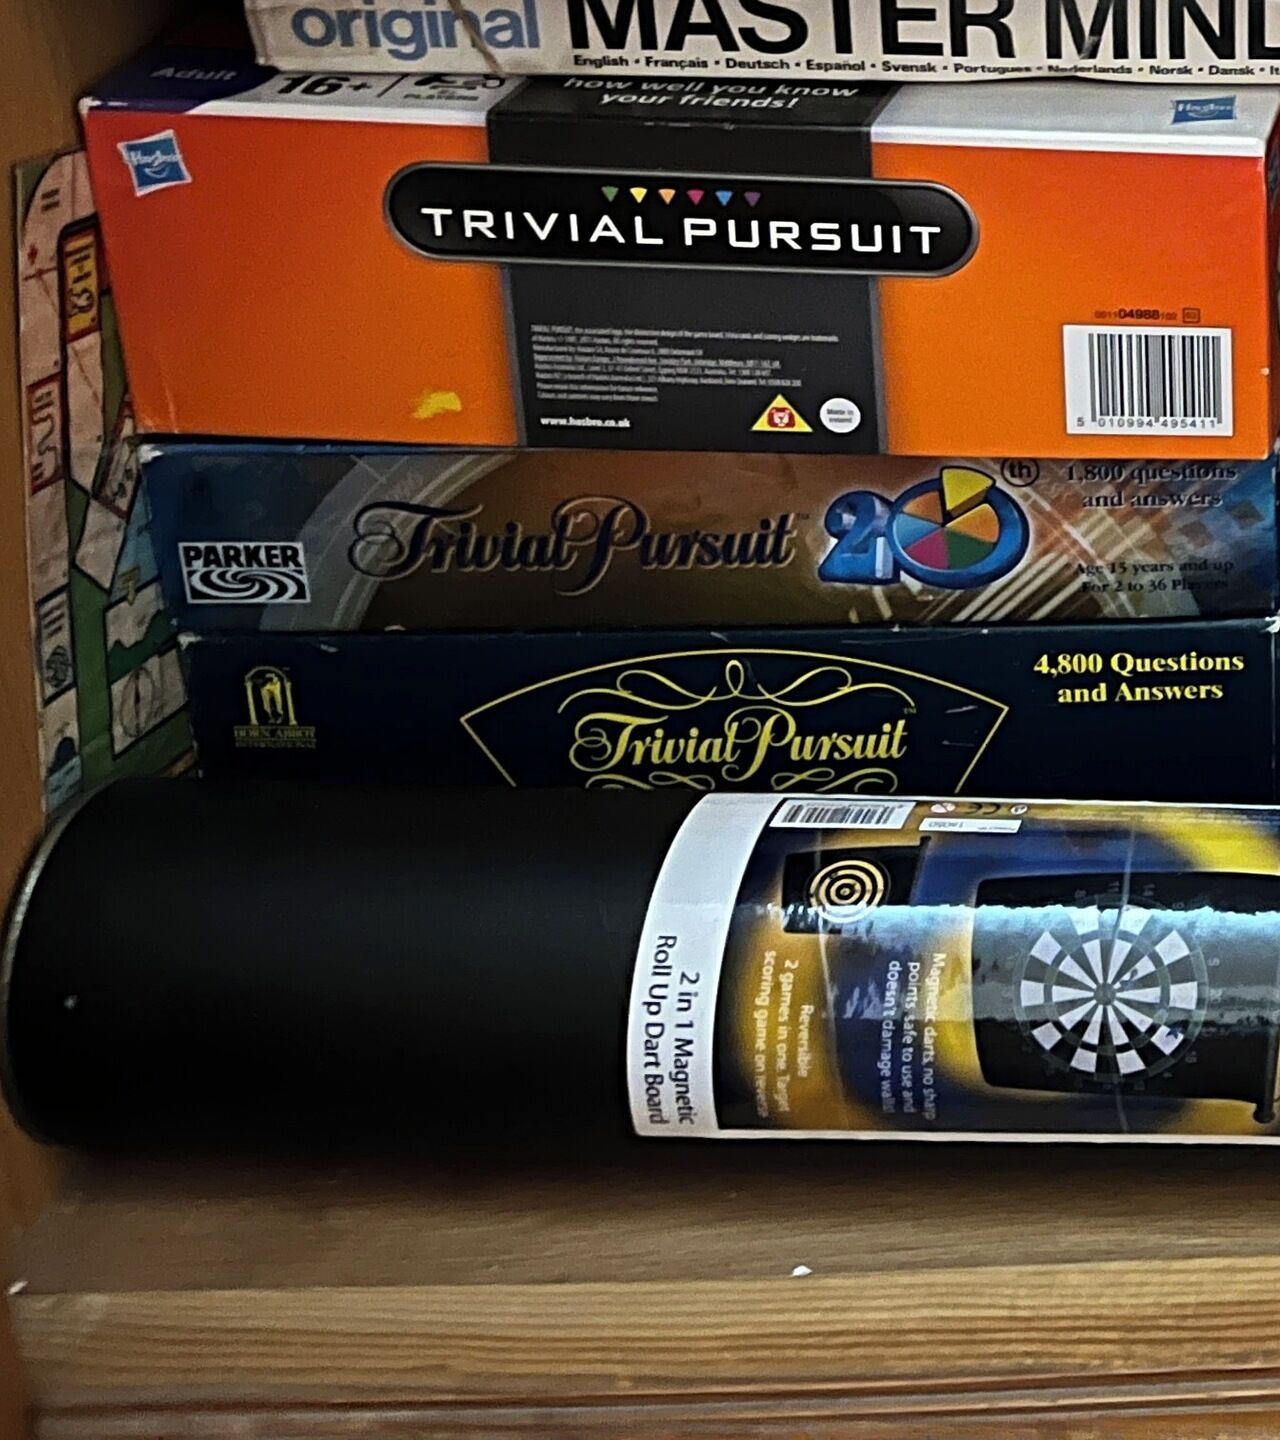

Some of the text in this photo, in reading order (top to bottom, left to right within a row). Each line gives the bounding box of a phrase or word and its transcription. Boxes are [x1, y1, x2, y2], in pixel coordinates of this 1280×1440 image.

[573, 55, 865, 73] English Français Deutsch Español
[421, 207, 942, 254] TRIVIAL PURSUIT
[183, 496, 798, 595] PARKER Trivial Pursuit
[1033, 652, 1244, 676] 4,800 Questions
[1057, 682, 1223, 703] and Answers
[569, 706, 907, 782] Trivial Pursuit
[643, 934, 677, 1125] Roll Up Dart Board
[669, 972, 699, 1126] 2 in 1 Magnetic
